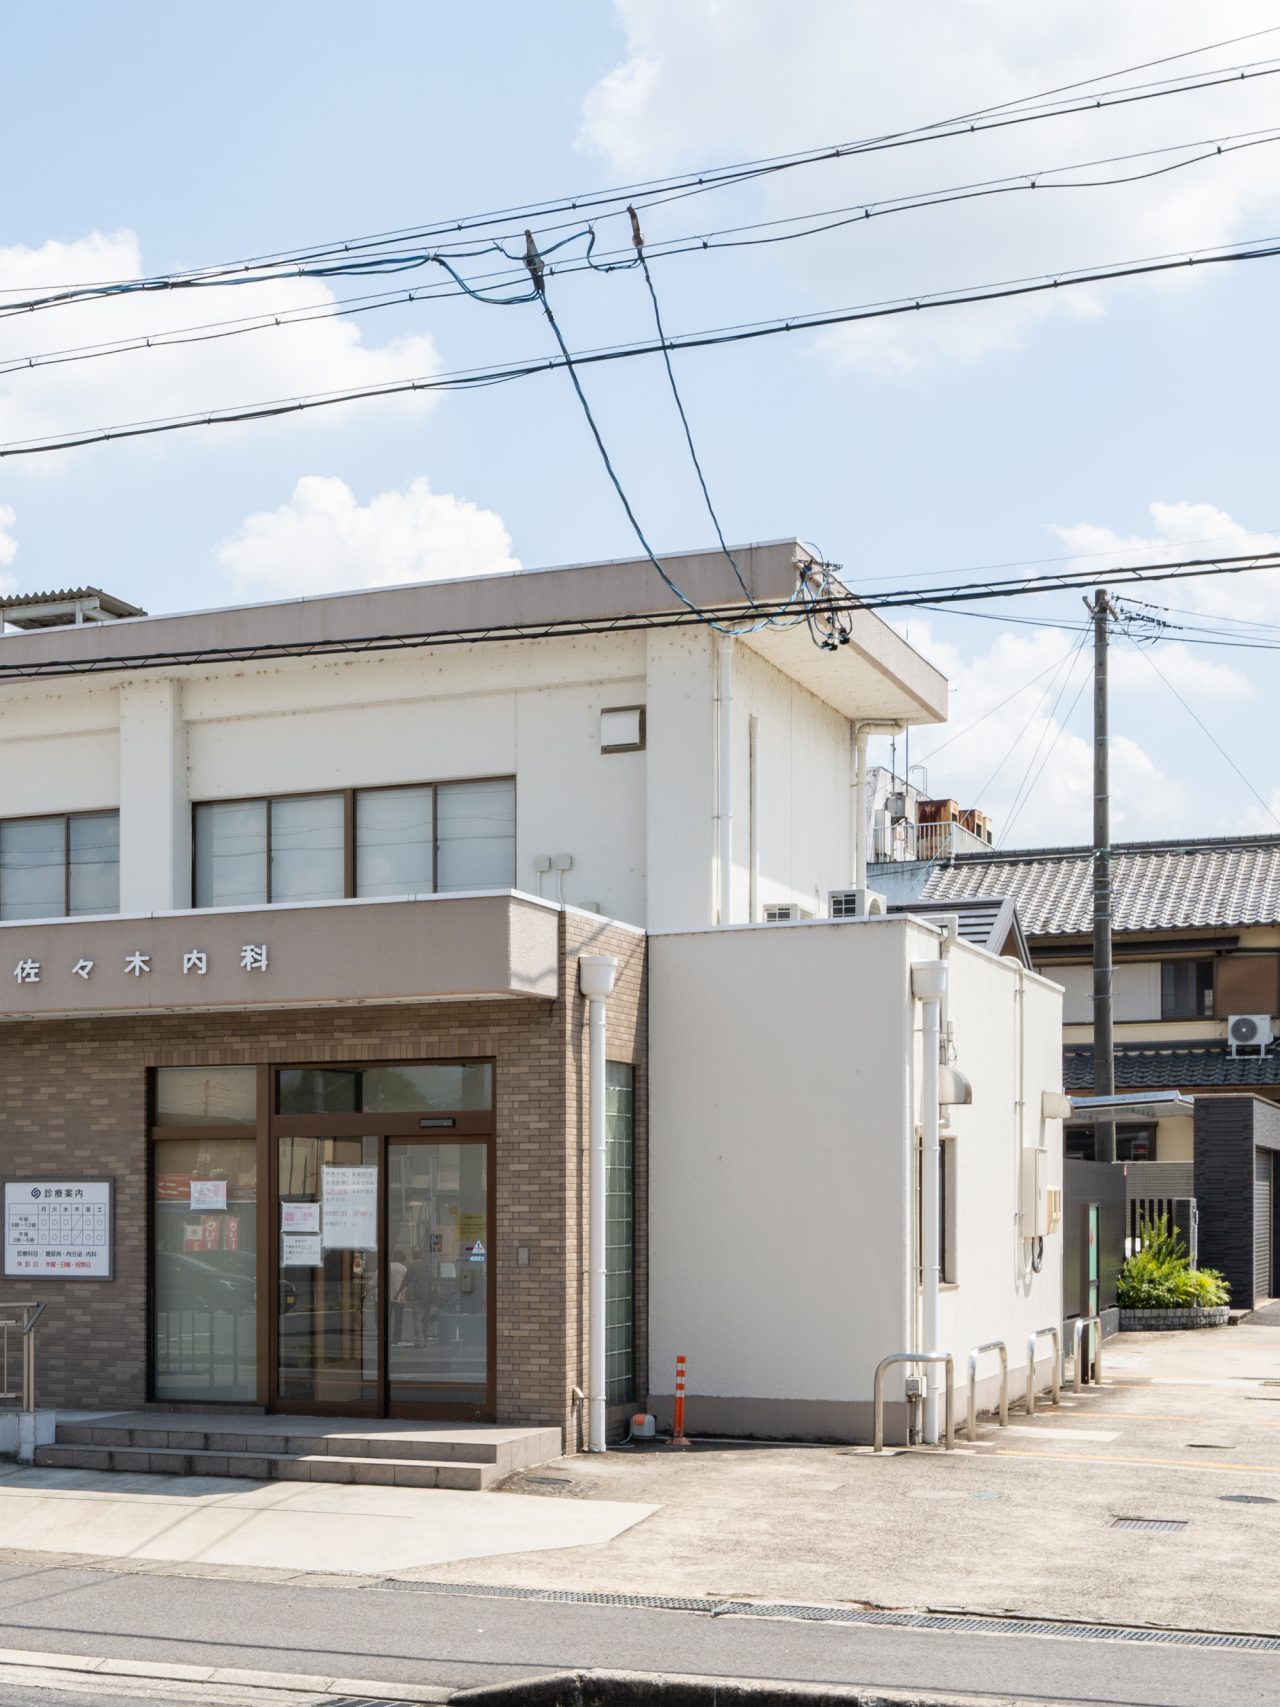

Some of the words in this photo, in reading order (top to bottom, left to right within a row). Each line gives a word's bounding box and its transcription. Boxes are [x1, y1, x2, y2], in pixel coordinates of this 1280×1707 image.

[13, 943, 269, 984] 佐々木内科
[44, 1189, 84, 1198] 診療案内
